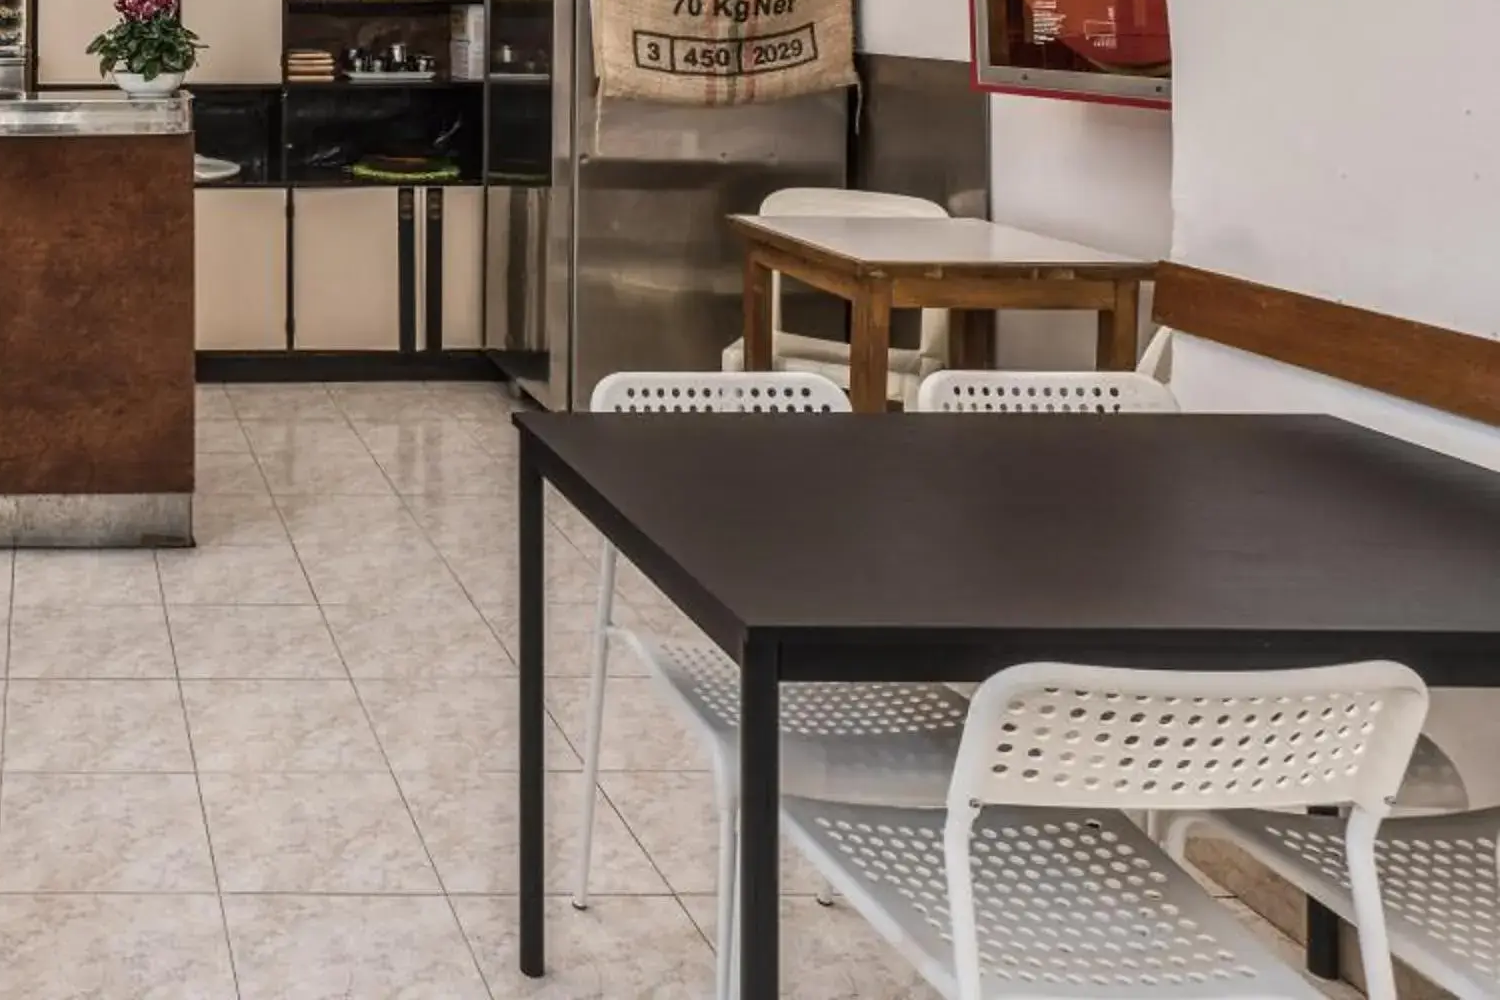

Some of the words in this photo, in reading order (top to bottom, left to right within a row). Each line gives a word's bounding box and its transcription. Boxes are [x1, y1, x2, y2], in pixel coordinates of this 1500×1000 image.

[647, 41, 660, 61] 3
[683, 47, 730, 68] 450
[752, 39, 803, 64] 2029
